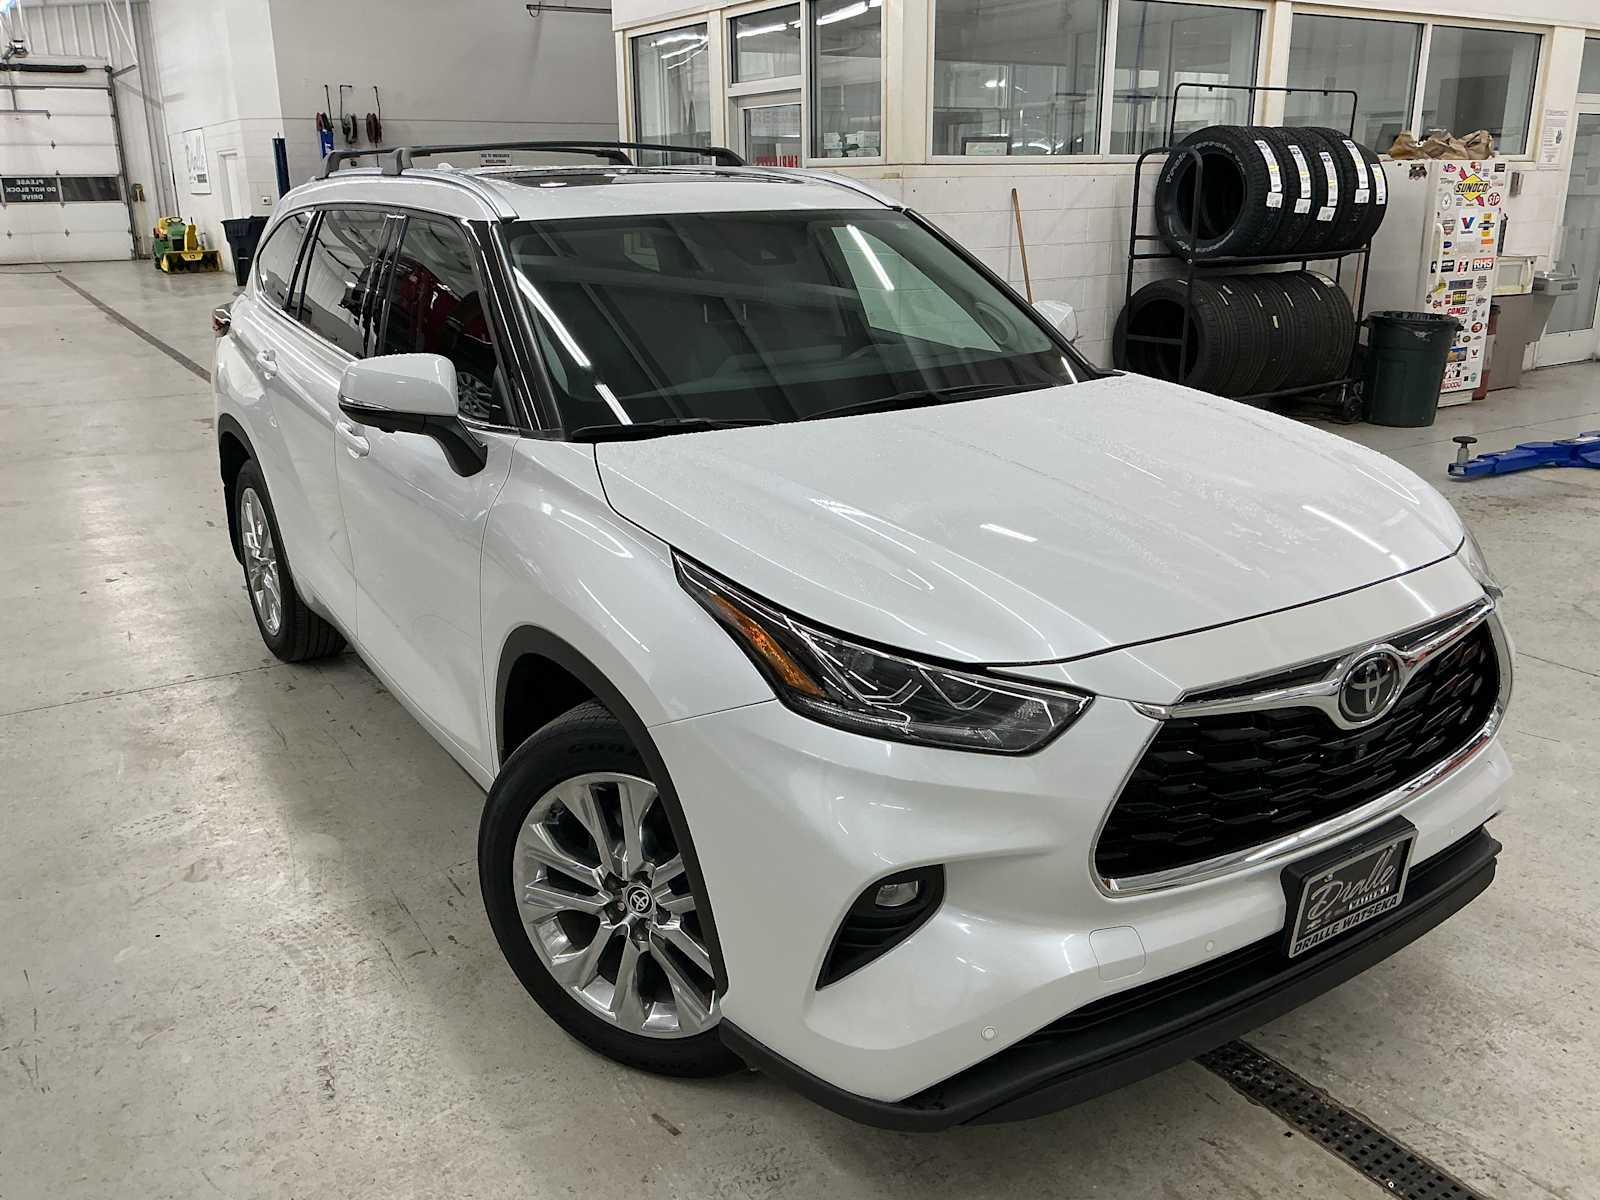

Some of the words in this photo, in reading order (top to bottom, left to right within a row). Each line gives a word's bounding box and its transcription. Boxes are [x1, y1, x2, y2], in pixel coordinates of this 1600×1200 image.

[1456, 182, 1489, 193] SUNOCO
[1473, 259, 1492, 270] RHS
[1308, 846, 1397, 920] Dralle
[1342, 896, 1397, 927] WATSEKA
[1294, 921, 1340, 953] DRALLE
